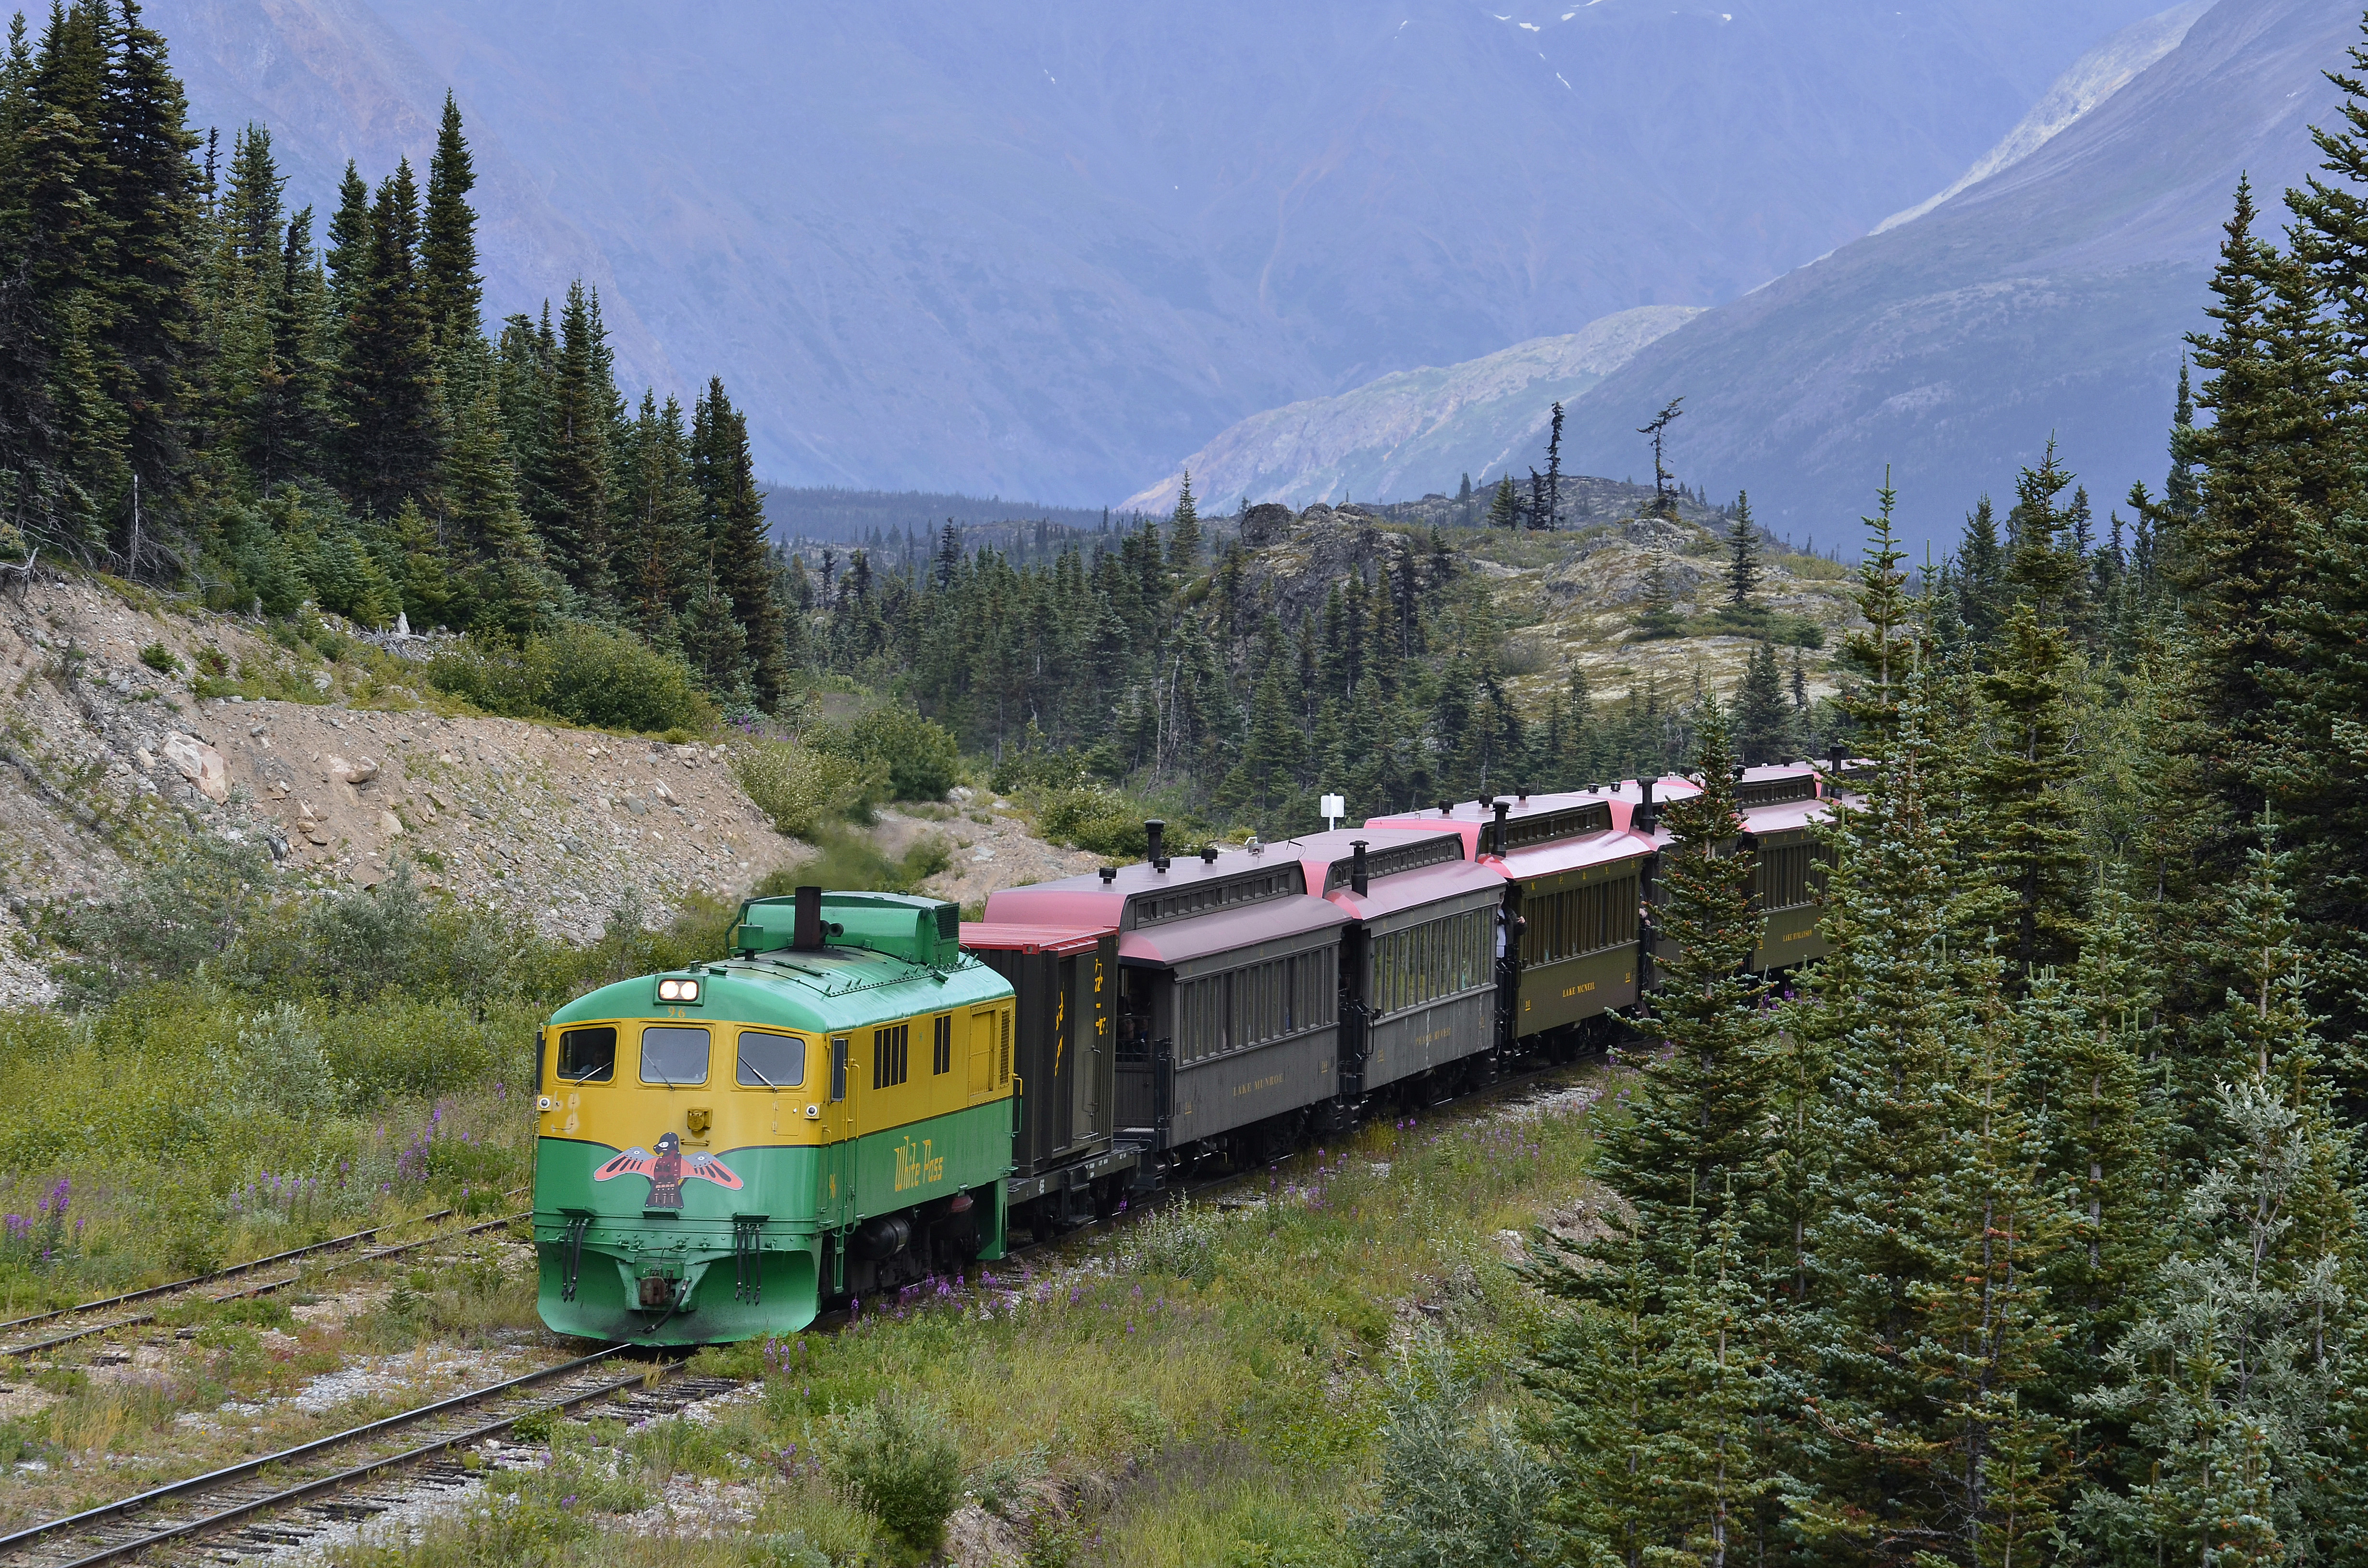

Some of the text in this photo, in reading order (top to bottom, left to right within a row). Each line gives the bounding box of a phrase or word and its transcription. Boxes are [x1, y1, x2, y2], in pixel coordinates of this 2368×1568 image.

[1563, 981, 1595, 997] LAKE MCNEIL
[667, 1006, 686, 1018] 96
[1233, 1073, 1283, 1096] LAKE MUNROE
[894, 1136, 943, 1192] White Pass
[829, 1173, 836, 1199] 96
